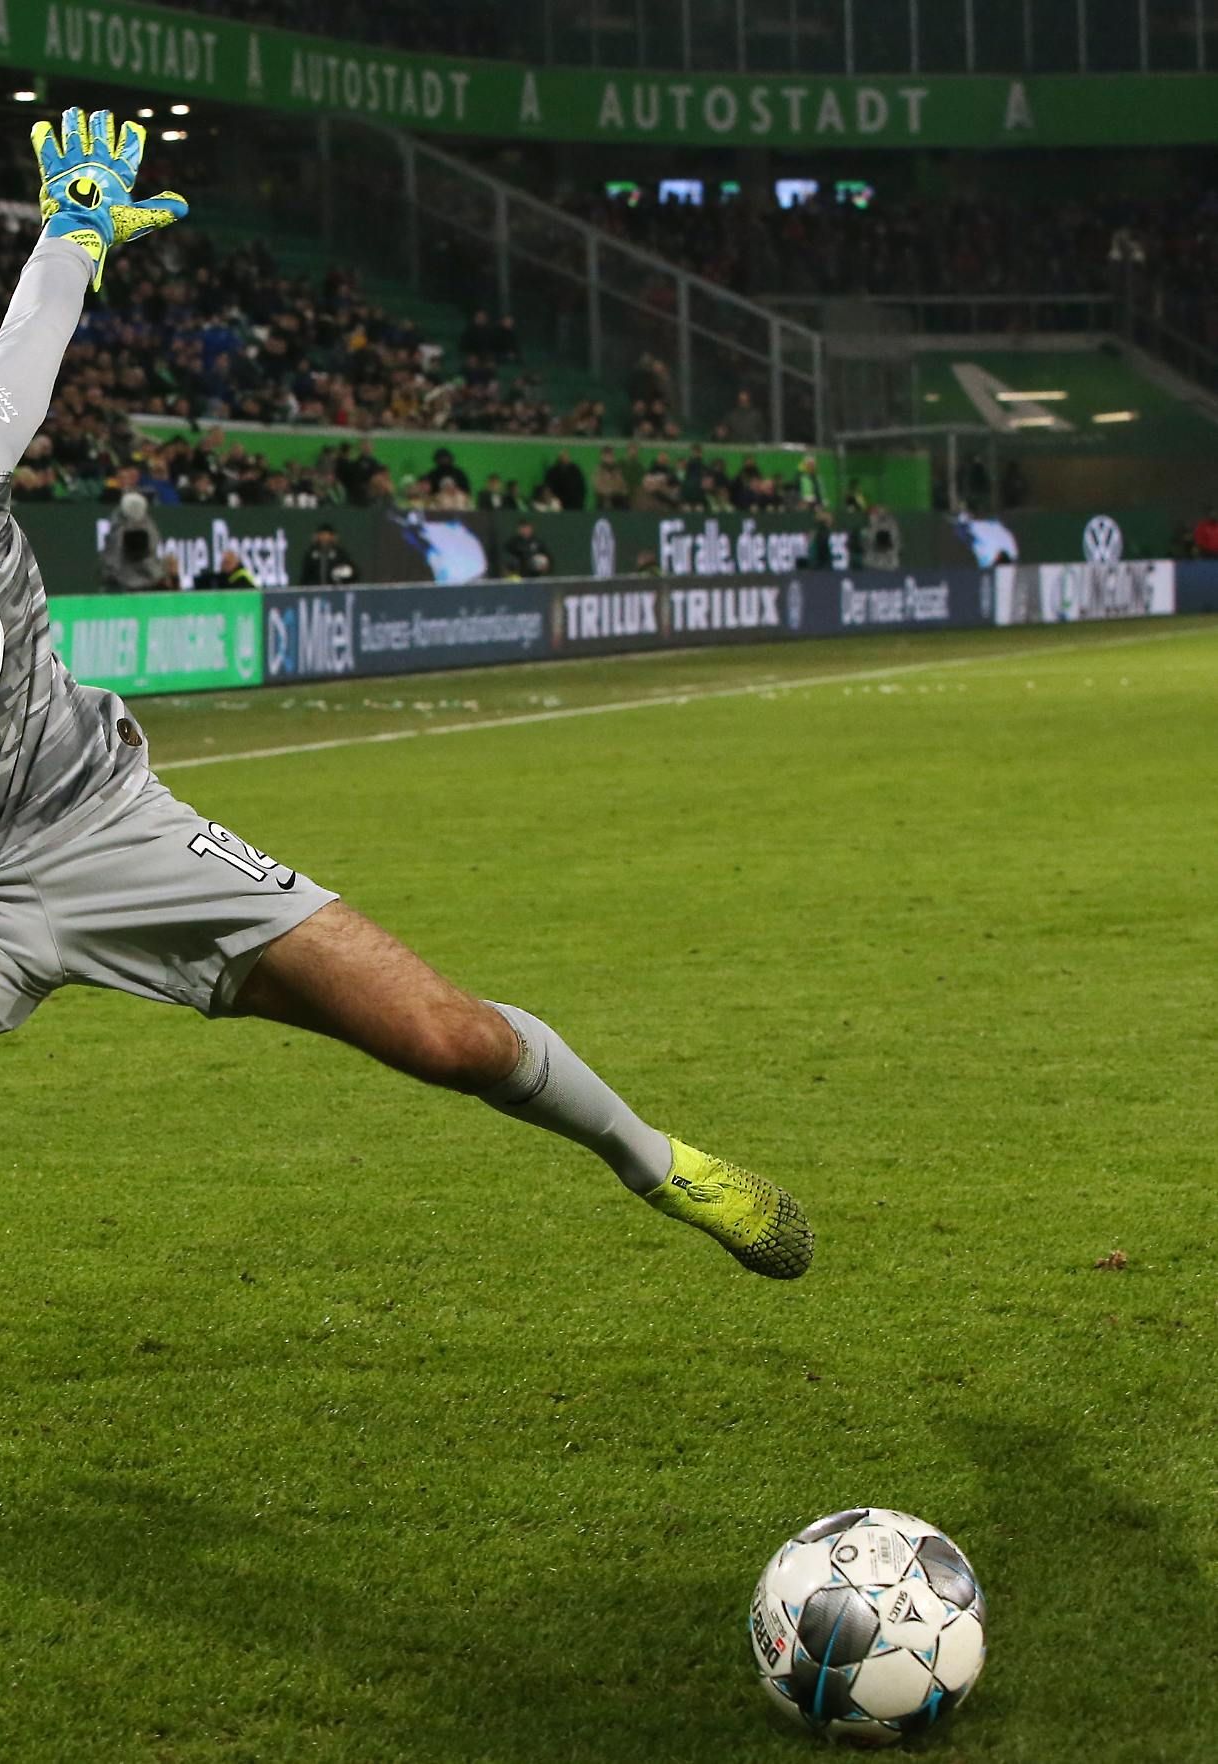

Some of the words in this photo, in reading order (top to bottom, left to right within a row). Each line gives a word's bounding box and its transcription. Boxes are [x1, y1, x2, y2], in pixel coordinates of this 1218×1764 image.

[44, 11, 218, 84] AUTOSTADT
[290, 52, 472, 122] AUTOSTADT
[598, 81, 930, 135] AUTOSTADT
[297, 592, 356, 675] Mitel
[564, 591, 658, 641] TRILUX
[670, 585, 780, 631] TRILUX
